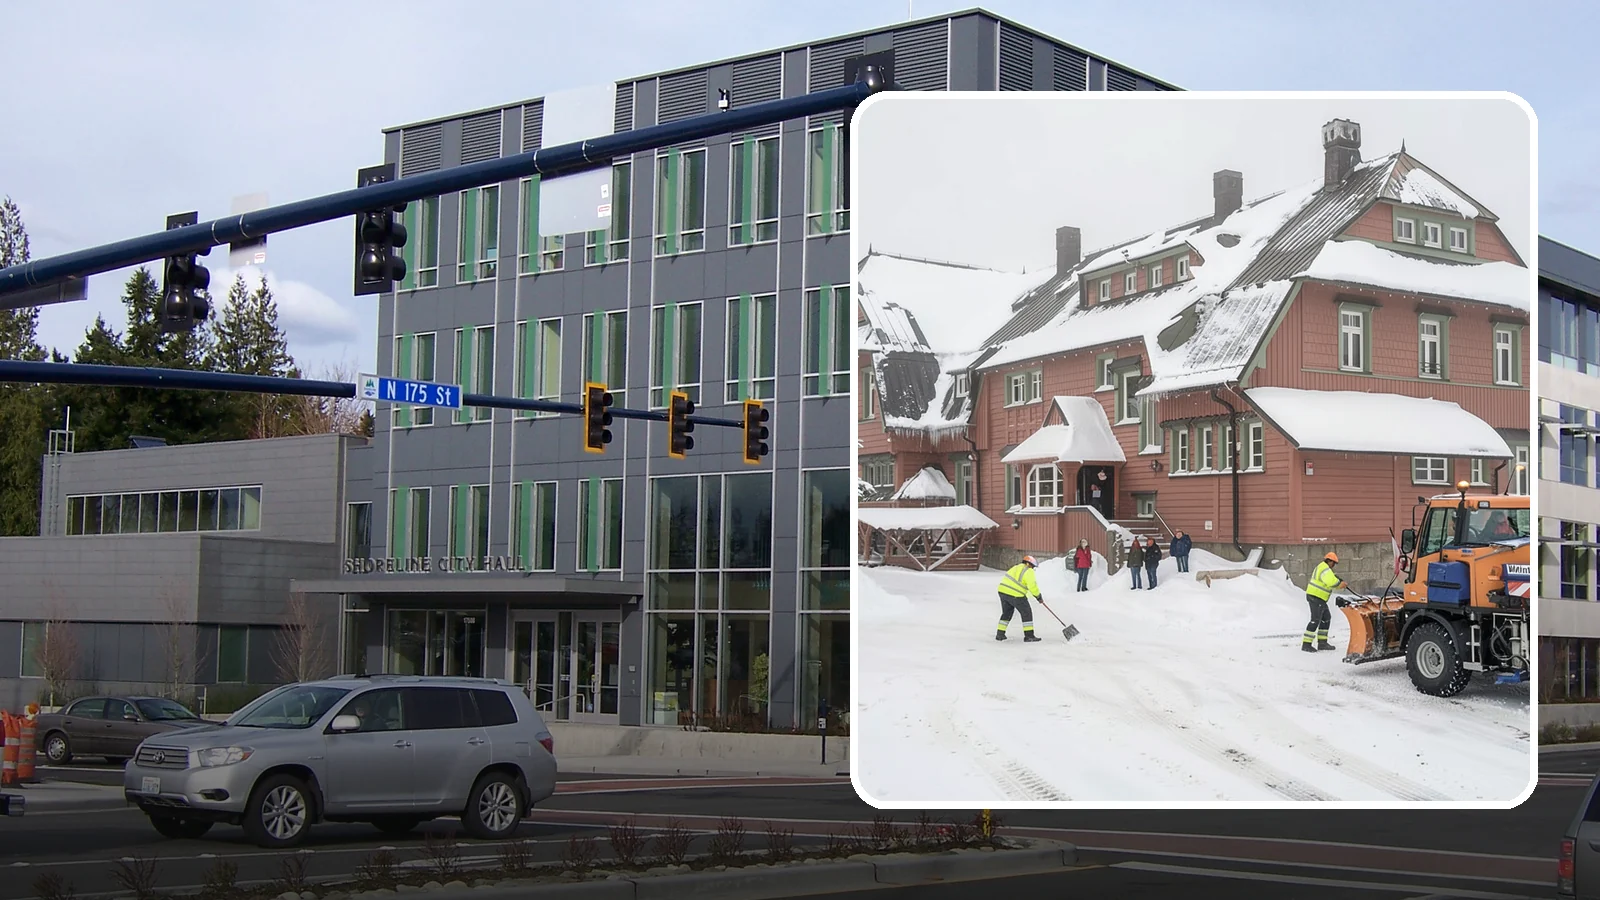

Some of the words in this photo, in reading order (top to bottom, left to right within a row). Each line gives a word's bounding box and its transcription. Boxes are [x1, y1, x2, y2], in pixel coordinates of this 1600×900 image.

[387, 380, 396, 400] N
[405, 382, 428, 403] 175
[436, 386, 451, 406] St
[344, 557, 432, 574] SHORELINE
[438, 556, 476, 572] CITY
[484, 555, 525, 571] HALL
